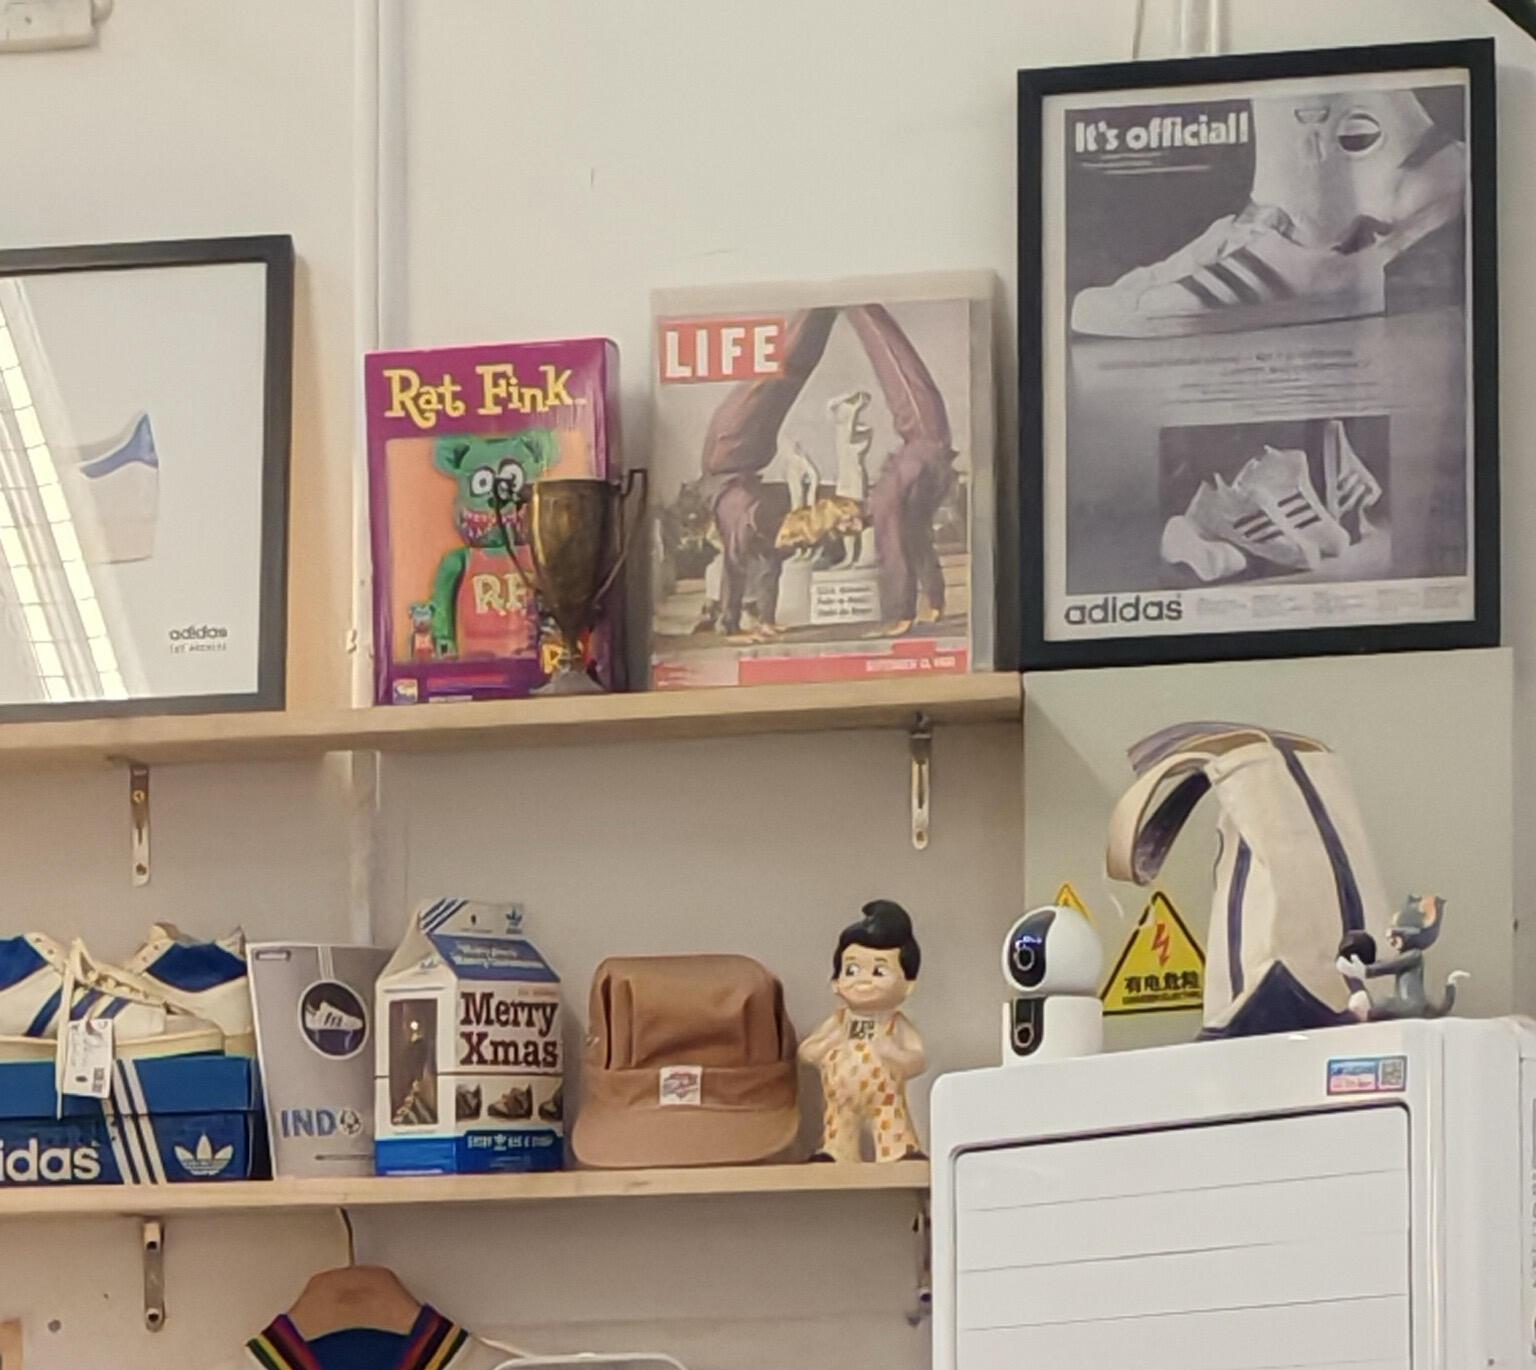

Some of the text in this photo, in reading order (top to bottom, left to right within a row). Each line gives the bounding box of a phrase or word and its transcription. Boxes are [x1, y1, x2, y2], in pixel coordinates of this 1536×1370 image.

[1075, 112, 1250, 153] It's official!
[666, 325, 783, 379] LIFE
[383, 363, 587, 429] Rat Fink
[1064, 595, 1183, 626] adidas
[169, 624, 228, 641] adidas
[460, 991, 560, 1038] Merry
[459, 1032, 559, 1069] Xmas
